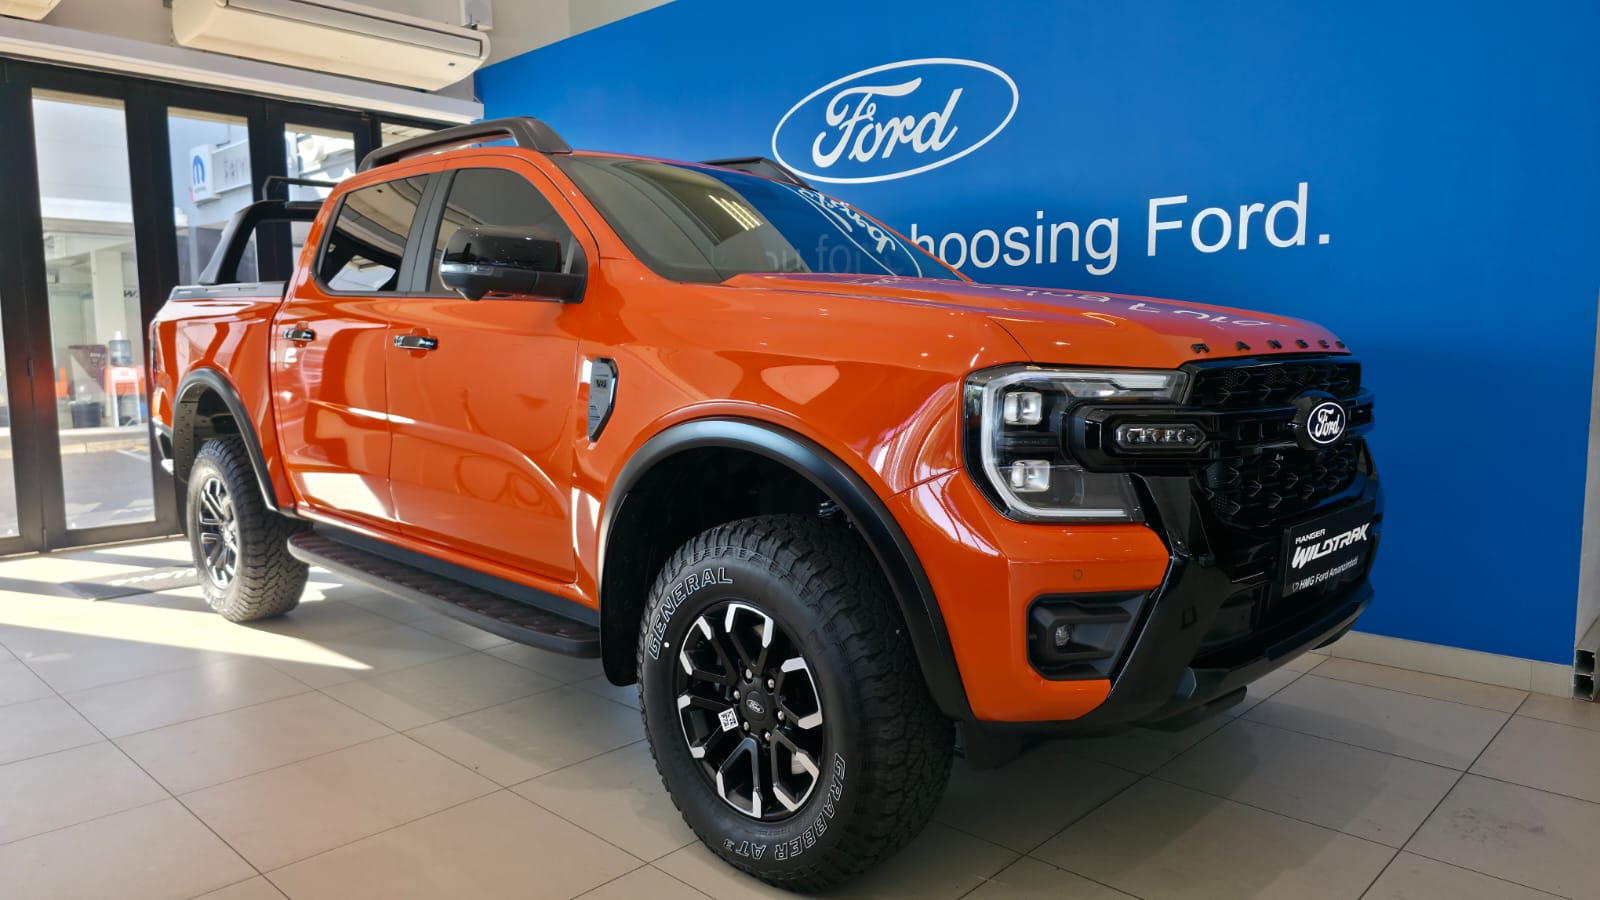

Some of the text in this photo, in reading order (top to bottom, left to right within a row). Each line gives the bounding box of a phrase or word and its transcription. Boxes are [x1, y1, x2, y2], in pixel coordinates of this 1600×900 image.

[812, 77, 963, 168] Ford
[911, 209, 1119, 276] hoosing
[1147, 182, 1331, 257] Ford.
[1314, 408, 1340, 438] Ford
[1291, 522, 1370, 569] WILDTRAK
[1295, 528, 1326, 545] RANGER
[648, 566, 734, 660] GENERAL
[1299, 575, 1315, 591] HMG
[1315, 569, 1330, 584] Ford
[774, 752, 846, 861] GRABBER
